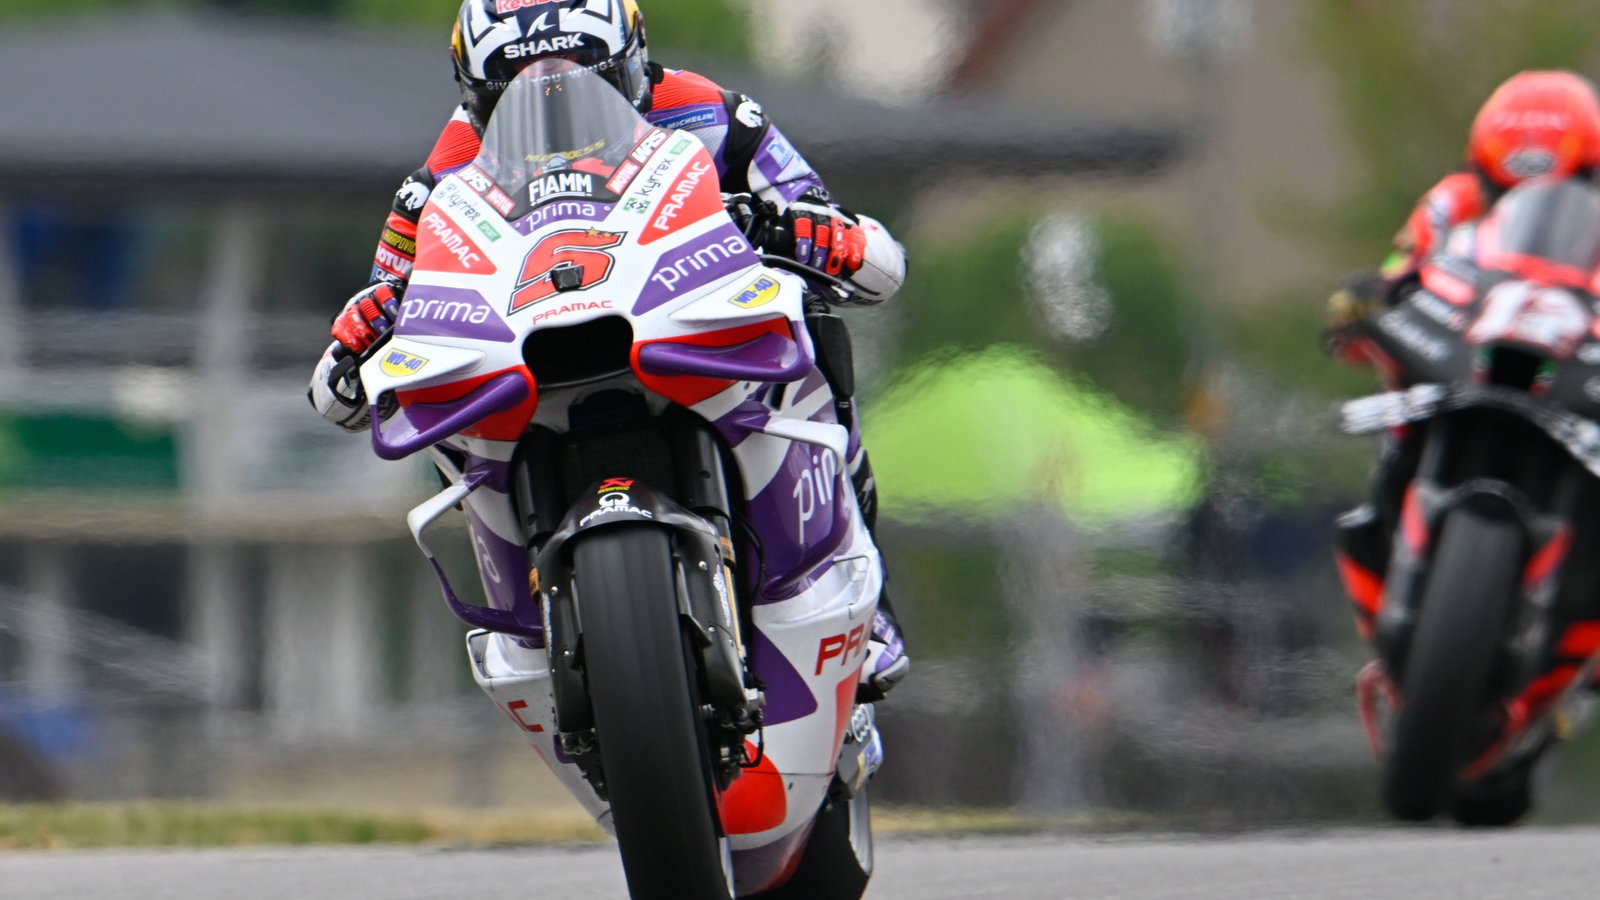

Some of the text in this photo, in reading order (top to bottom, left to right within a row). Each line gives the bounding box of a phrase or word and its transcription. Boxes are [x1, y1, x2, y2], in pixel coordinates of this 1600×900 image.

[503, 32, 584, 59] SHARK
[530, 73, 561, 85] YOU
[666, 111, 715, 130] MICHELIN
[529, 173, 593, 203] FIAMM
[653, 161, 710, 231] PRAMAC
[526, 202, 596, 232] prima
[421, 213, 480, 269] PRAMAC
[507, 228, 629, 317] 5
[651, 235, 748, 292] prima
[734, 278, 775, 305] WD-40
[399, 297, 491, 327] prima
[532, 299, 614, 326] PRAMAC
[385, 351, 424, 370] WD-40
[579, 504, 653, 527] PRAMAC
